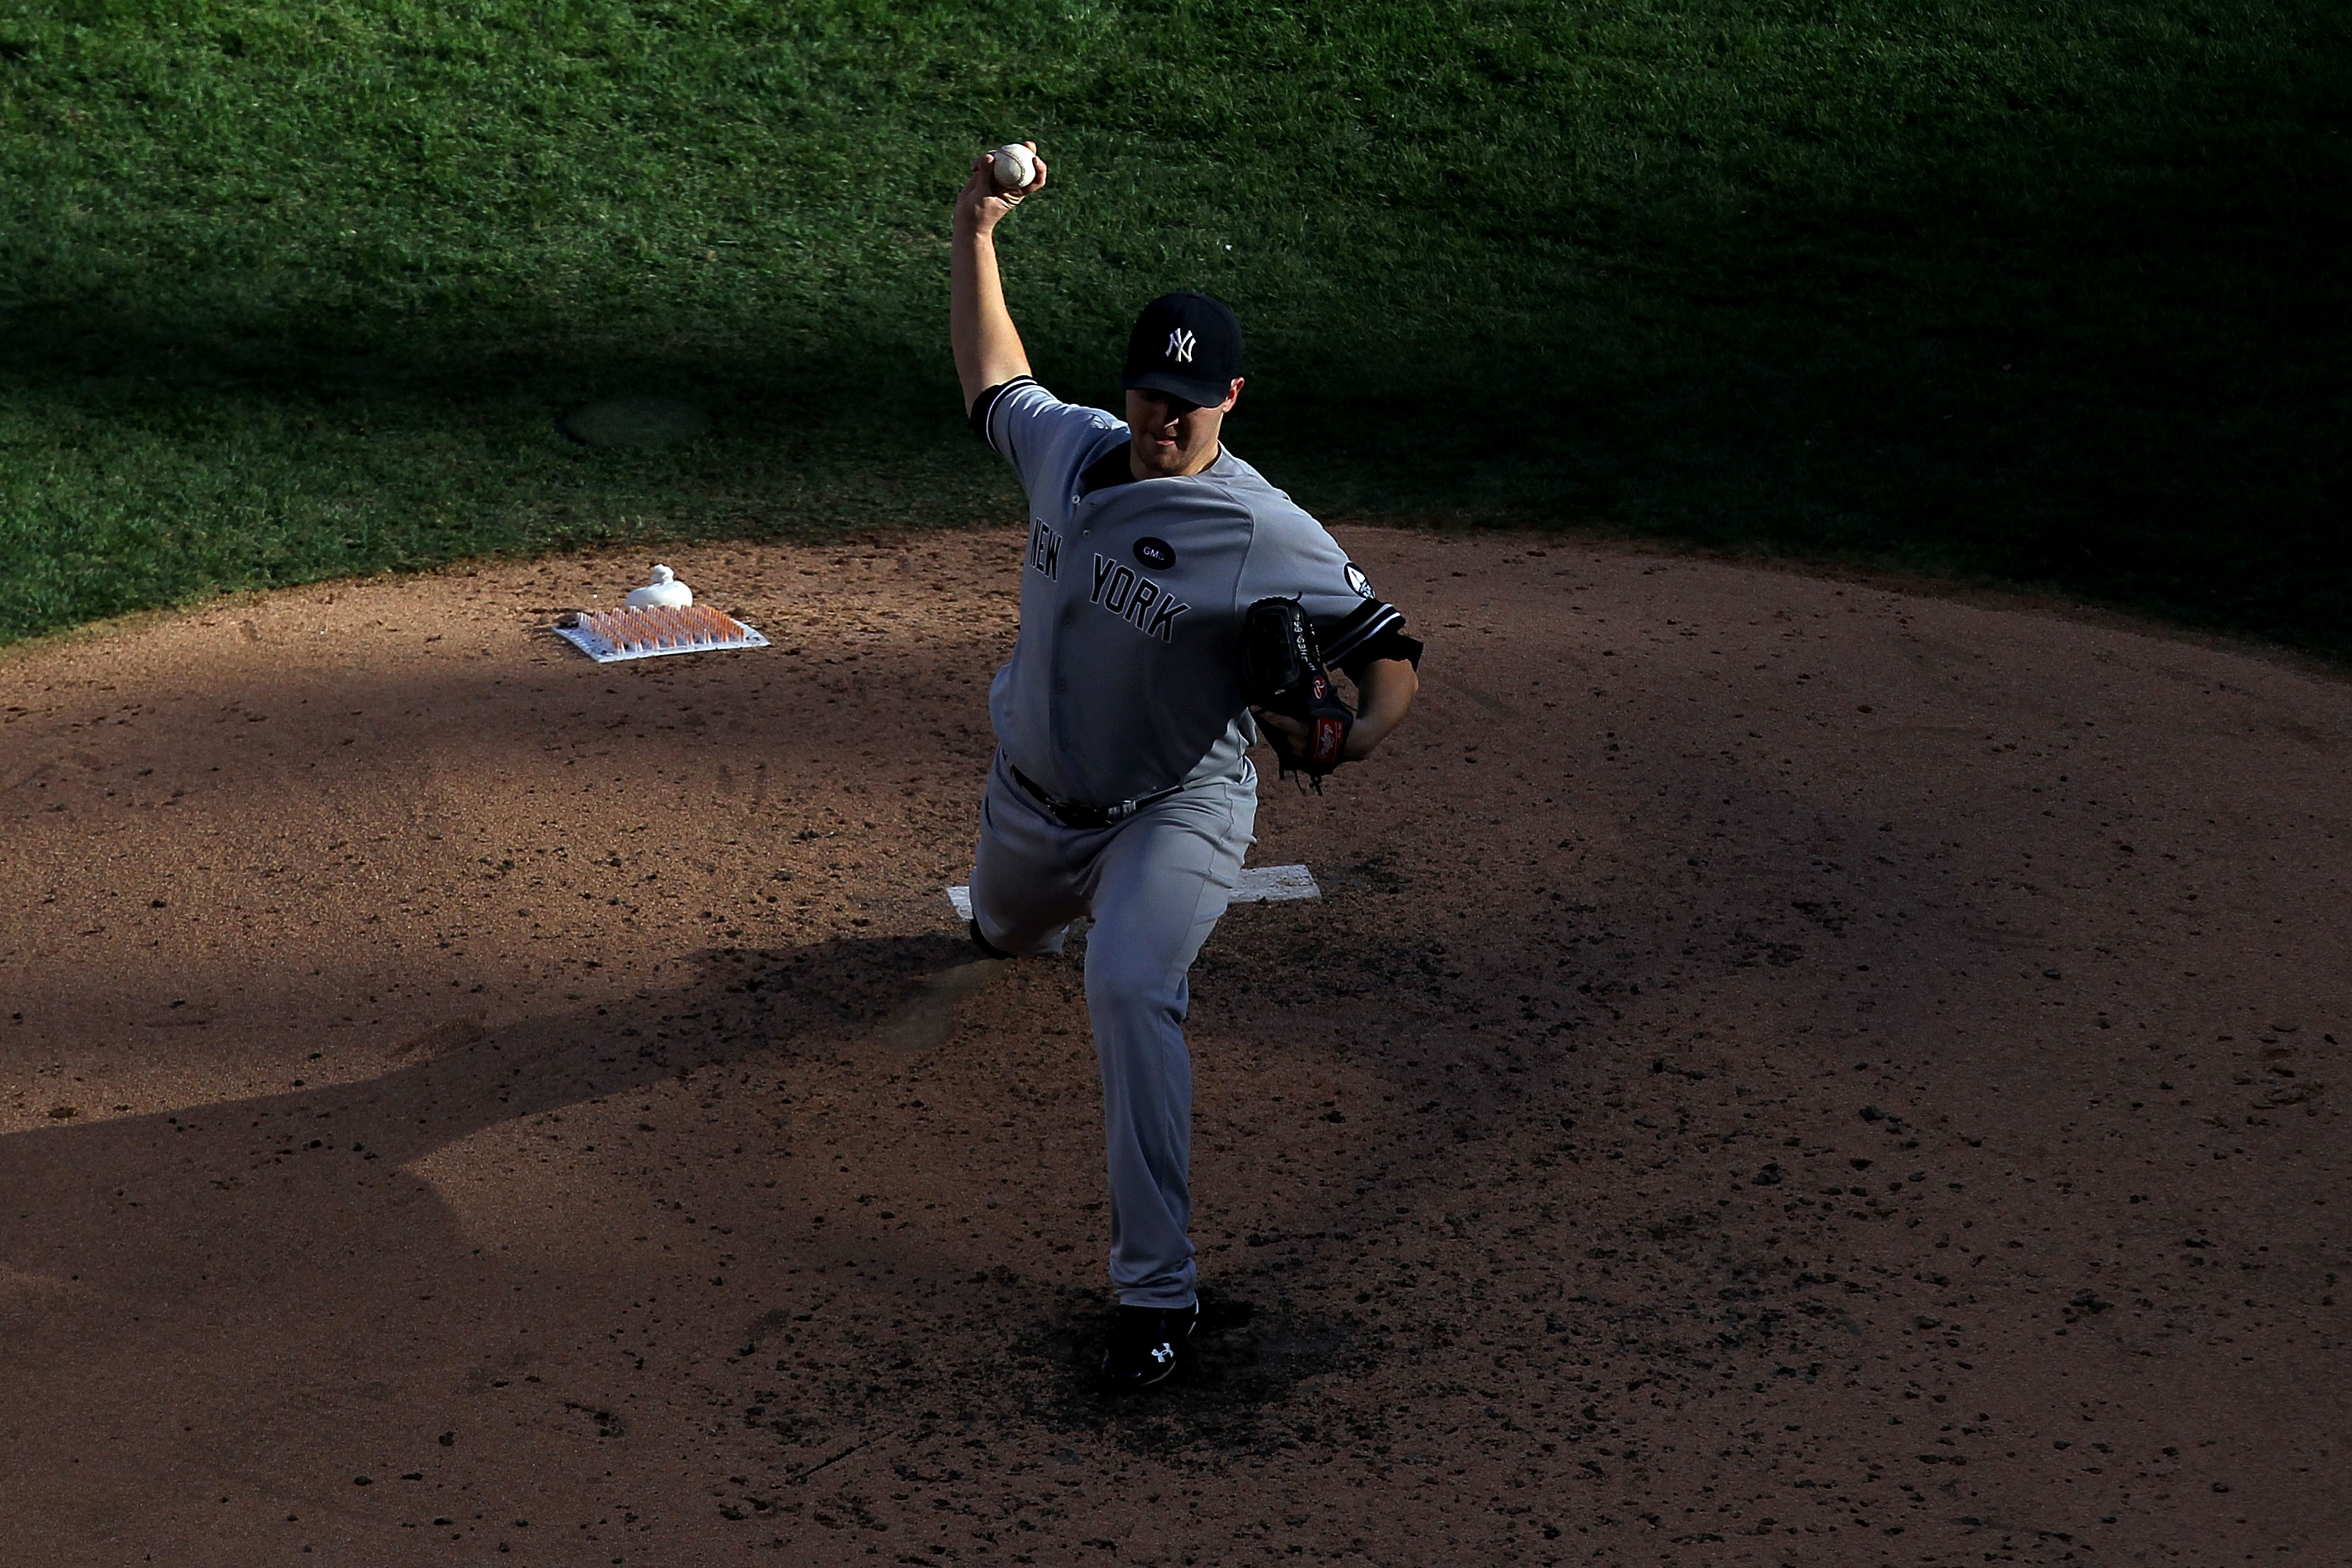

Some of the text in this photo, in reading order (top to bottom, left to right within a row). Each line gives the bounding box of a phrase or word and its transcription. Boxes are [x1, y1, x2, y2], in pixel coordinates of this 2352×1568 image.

[1165, 327, 1197, 362] NY
[1143, 546, 1165, 561] GMS
[1031, 517, 1192, 643] NEW YORK
